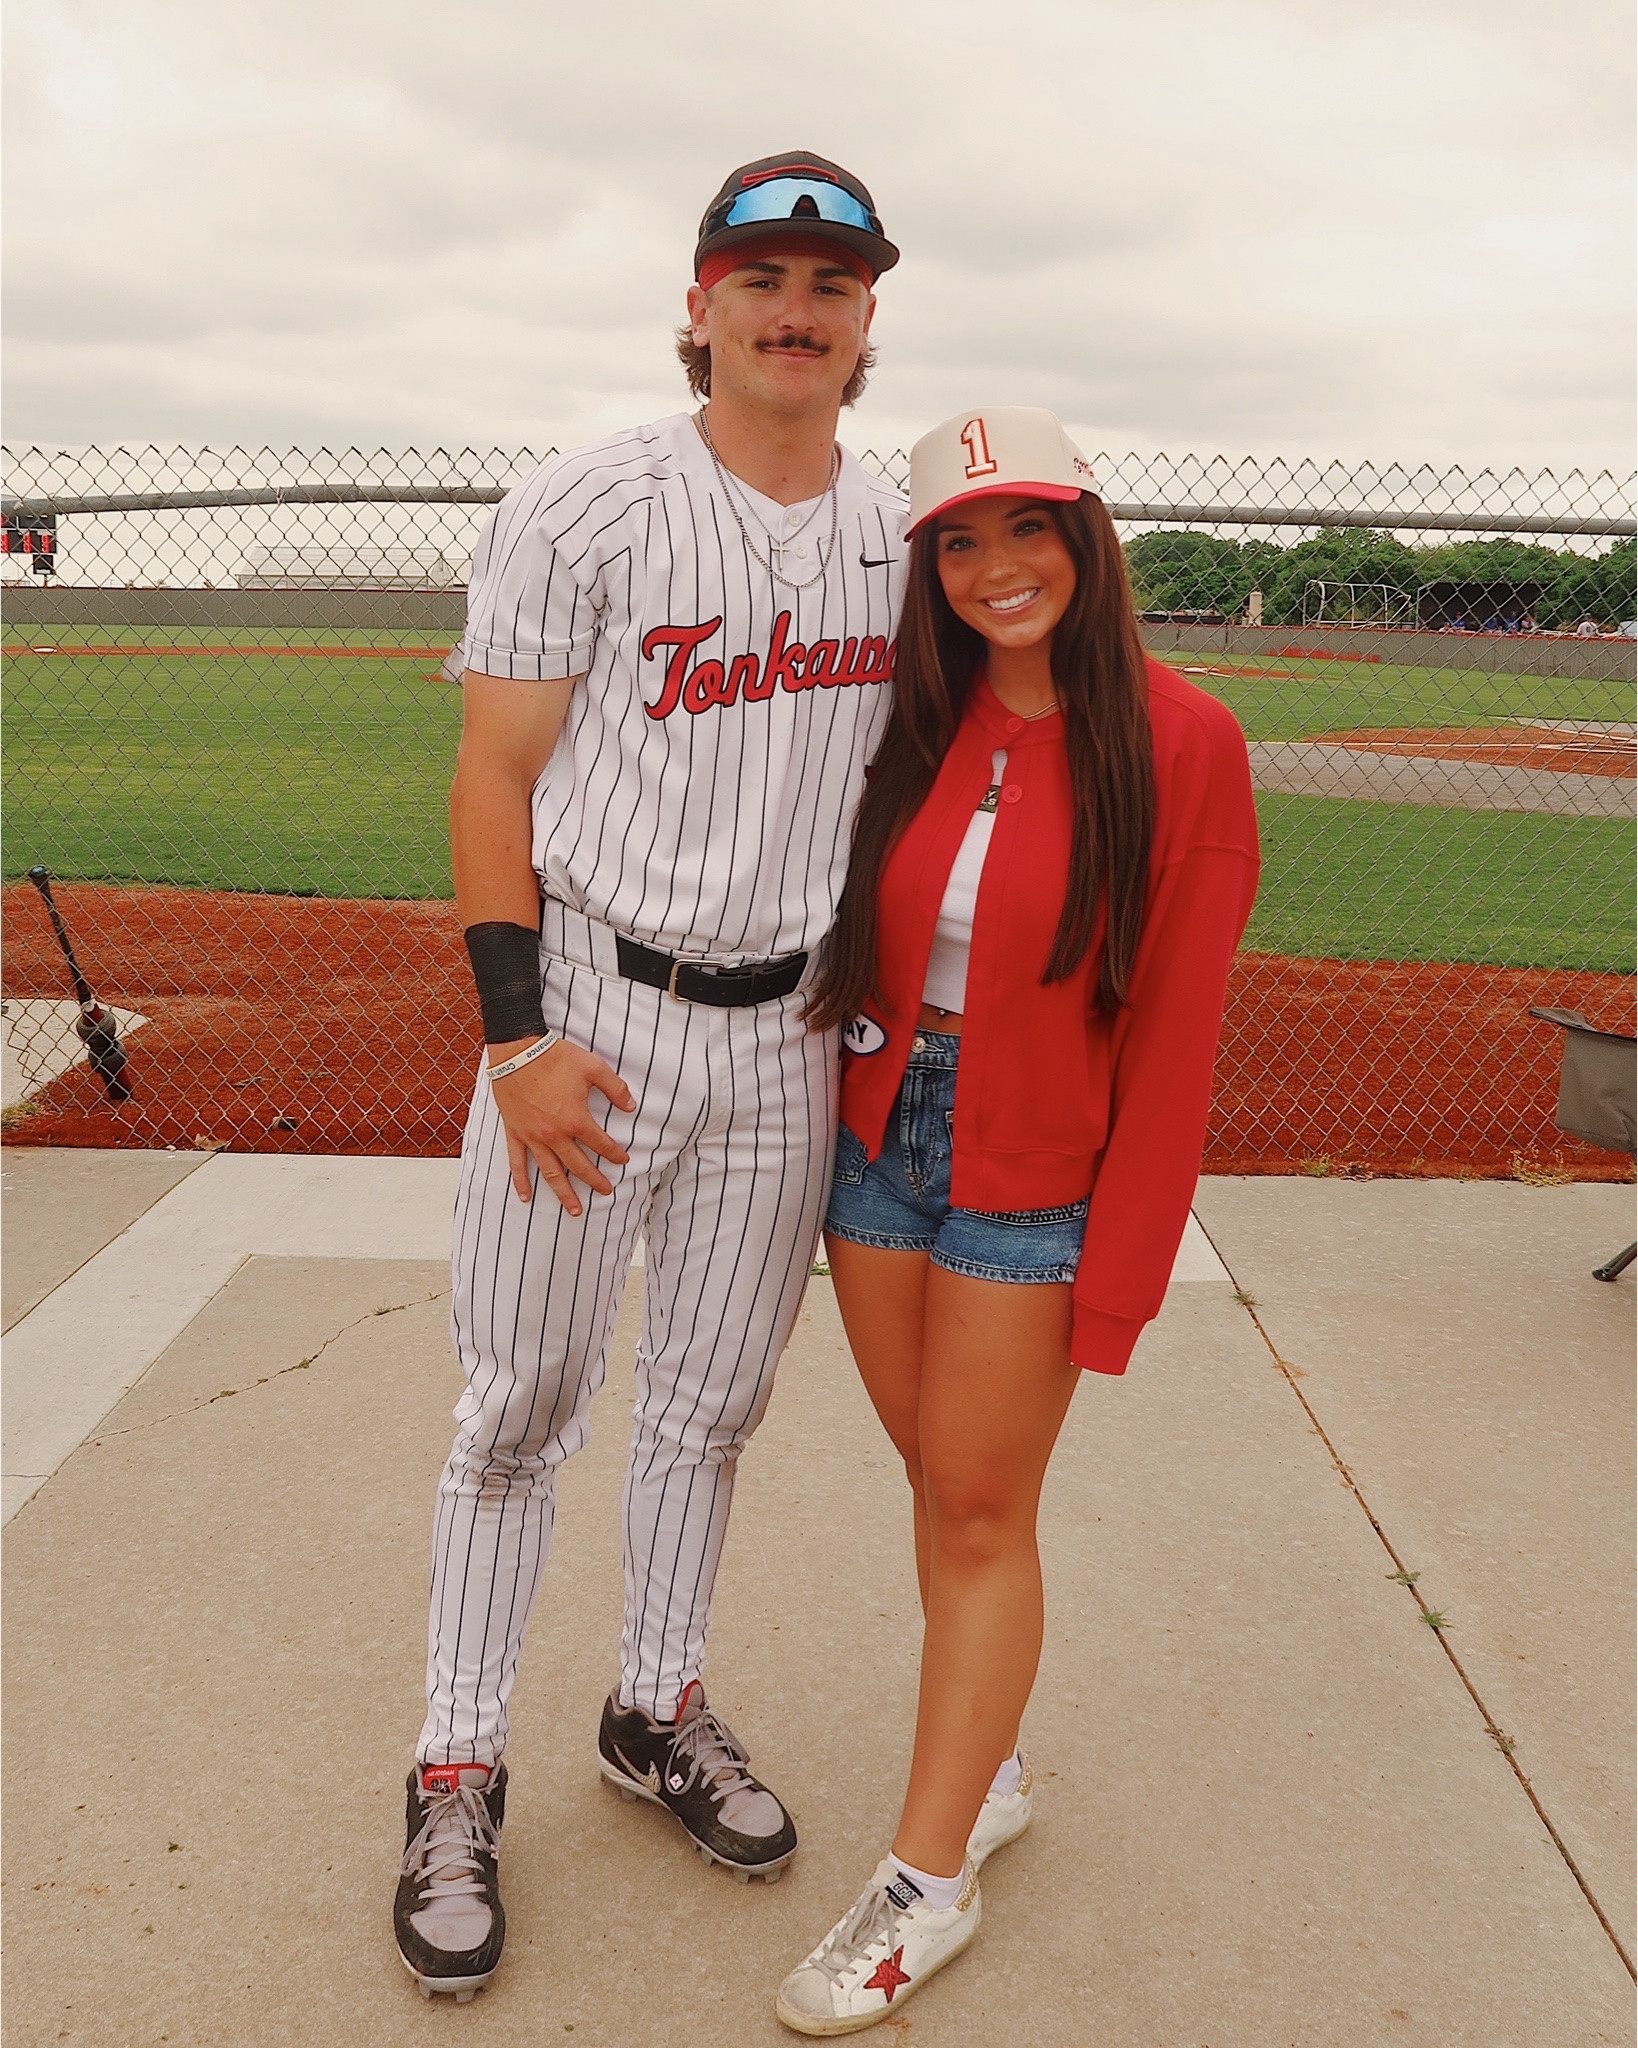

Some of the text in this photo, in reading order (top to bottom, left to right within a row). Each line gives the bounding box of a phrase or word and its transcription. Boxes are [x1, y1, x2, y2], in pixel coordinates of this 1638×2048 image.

[960, 417, 998, 480] 1
[641, 609, 898, 720] Tonkaw
[846, 1019, 868, 1045] AY
[893, 1882, 917, 1903] GGDB
